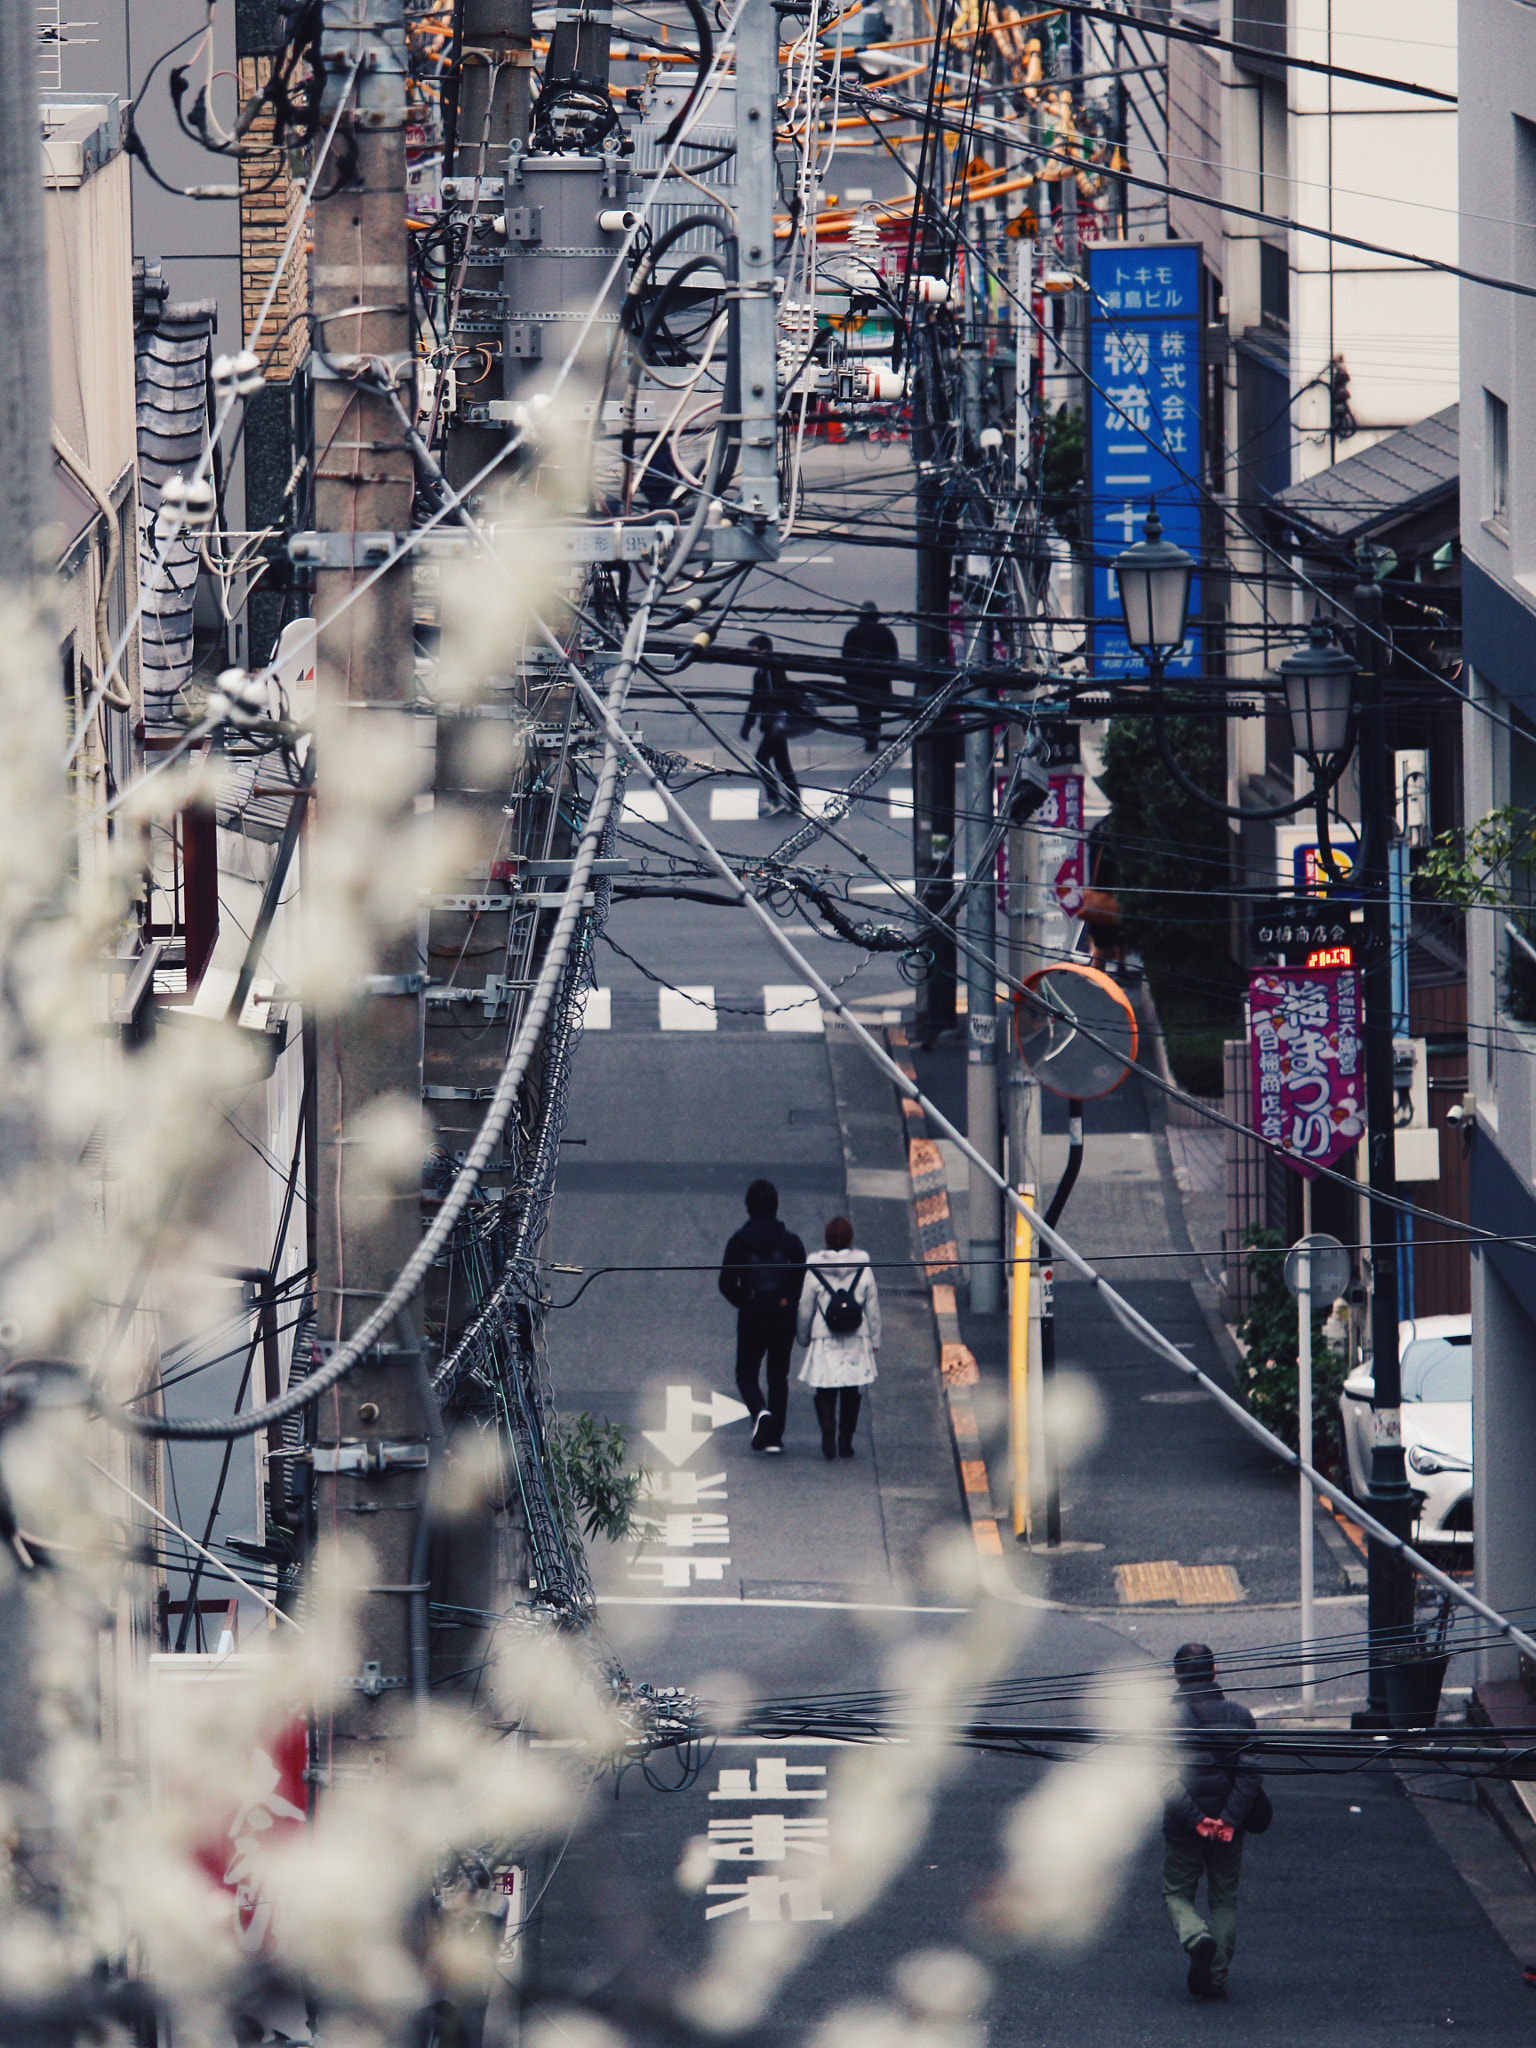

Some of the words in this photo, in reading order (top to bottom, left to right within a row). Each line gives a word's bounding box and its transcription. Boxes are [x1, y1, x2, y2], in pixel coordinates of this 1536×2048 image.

[1105, 289, 1183, 309] 湯島ビル
[1115, 267, 1174, 285] トキモ
[1160, 331, 1187, 453] 株式会社
[1258, 924, 1347, 944] 白梅商店会
[1259, 1030, 1282, 1137] 白梅商店会
[1283, 980, 1332, 1157] 梅まつり
